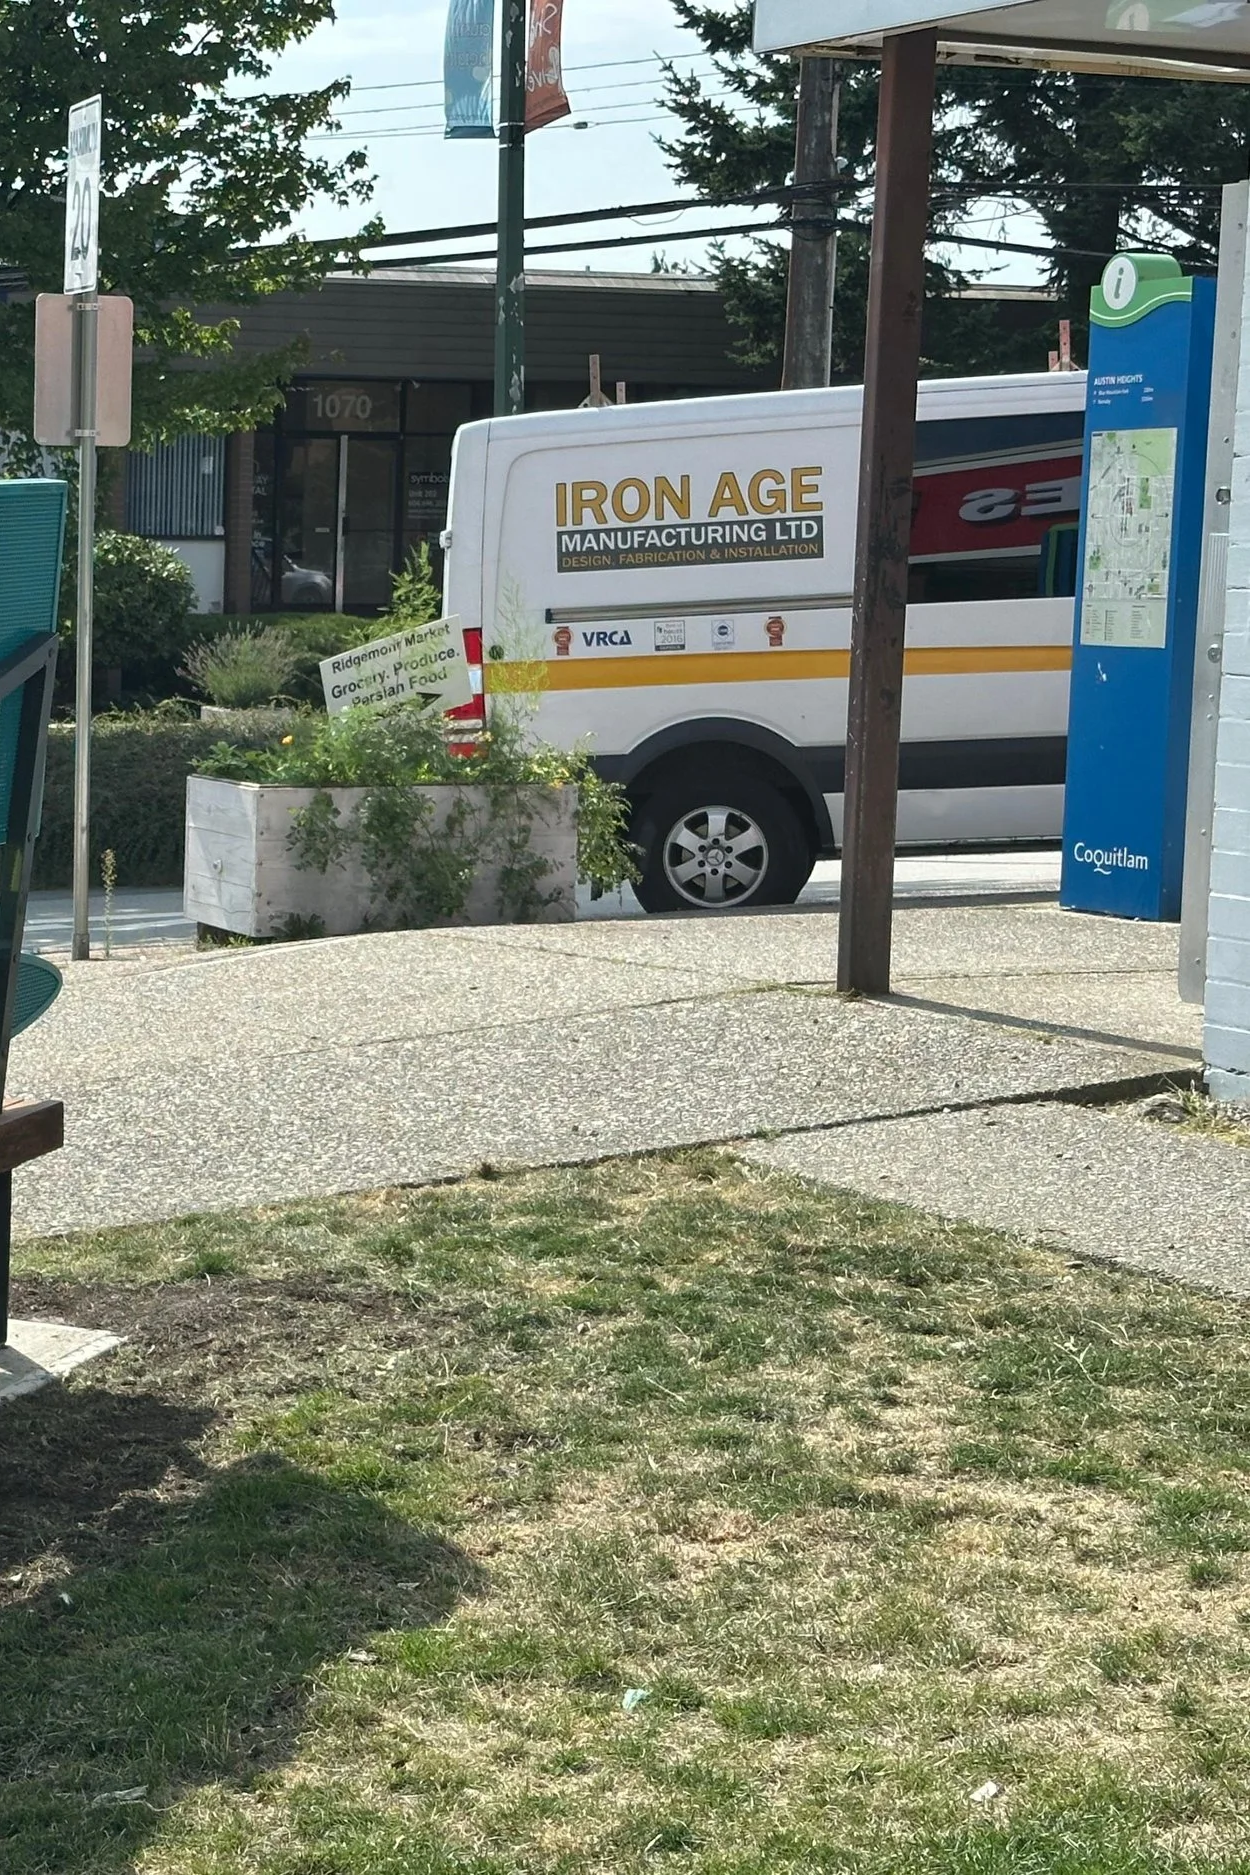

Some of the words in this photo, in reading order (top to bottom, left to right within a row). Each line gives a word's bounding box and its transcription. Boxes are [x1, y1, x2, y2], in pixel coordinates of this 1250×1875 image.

[71, 177, 91, 261] 20
[1094, 376, 1115, 385] AUSTIN
[1116, 374, 1143, 384] HEIGHTS
[313, 394, 373, 420] 1070
[556, 475, 690, 527] IRON
[708, 466, 823, 517] AGE
[561, 524, 767, 552] MANUFACTURING
[775, 520, 818, 540] LTD
[619, 550, 705, 565] FABRICATION
[710, 549, 720, 559] &
[724, 543, 819, 559] INSTALLATION
[405, 624, 450, 648] Market
[582, 630, 632, 647] VRCA
[661, 634, 683, 643] 2016
[352, 682, 405, 706] Persian
[409, 667, 447, 689] Food
[1074, 842, 1148, 875] Coquitlam
